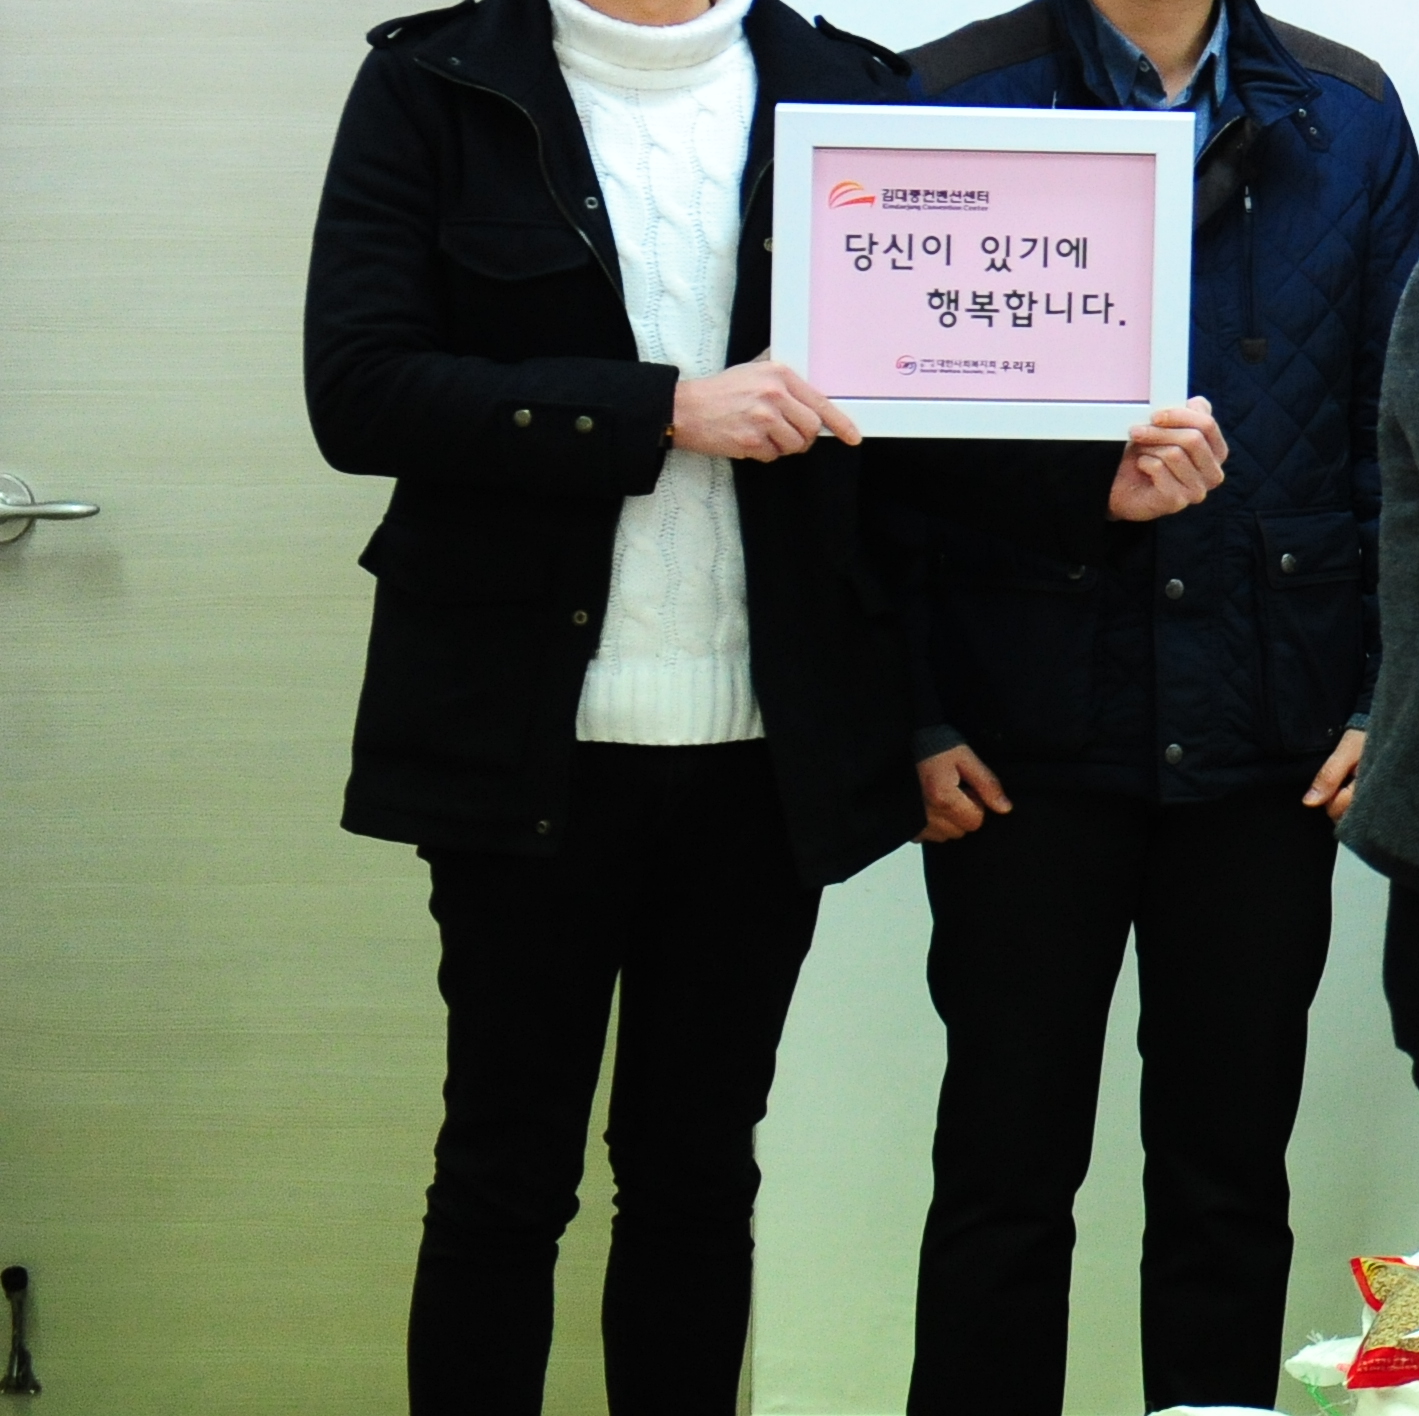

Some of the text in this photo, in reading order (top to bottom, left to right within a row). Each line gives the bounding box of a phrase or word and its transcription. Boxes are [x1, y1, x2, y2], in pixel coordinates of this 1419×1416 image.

[882, 188, 989, 204] 김대중컨벤션센터
[845, 233, 1088, 272] 당신이 있기에
[927, 288, 1126, 328] 행복합니다.
[1000, 360, 1035, 374] 우리집
